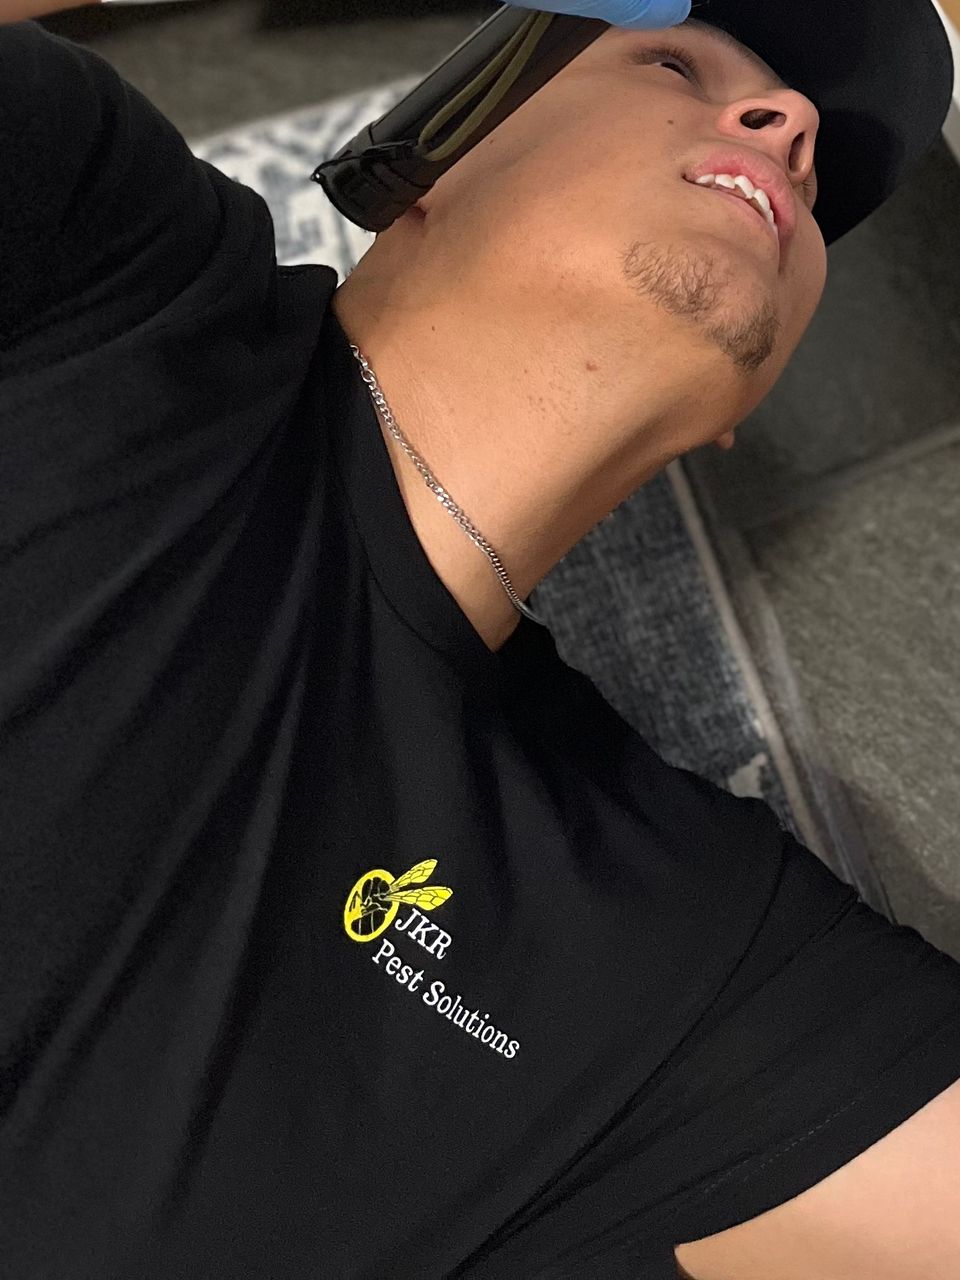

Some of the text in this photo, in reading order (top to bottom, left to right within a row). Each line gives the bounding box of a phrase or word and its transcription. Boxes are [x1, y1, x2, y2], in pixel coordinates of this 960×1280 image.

[394, 908, 452, 960] JKR
[371, 938, 520, 1059] Pest Solutions
